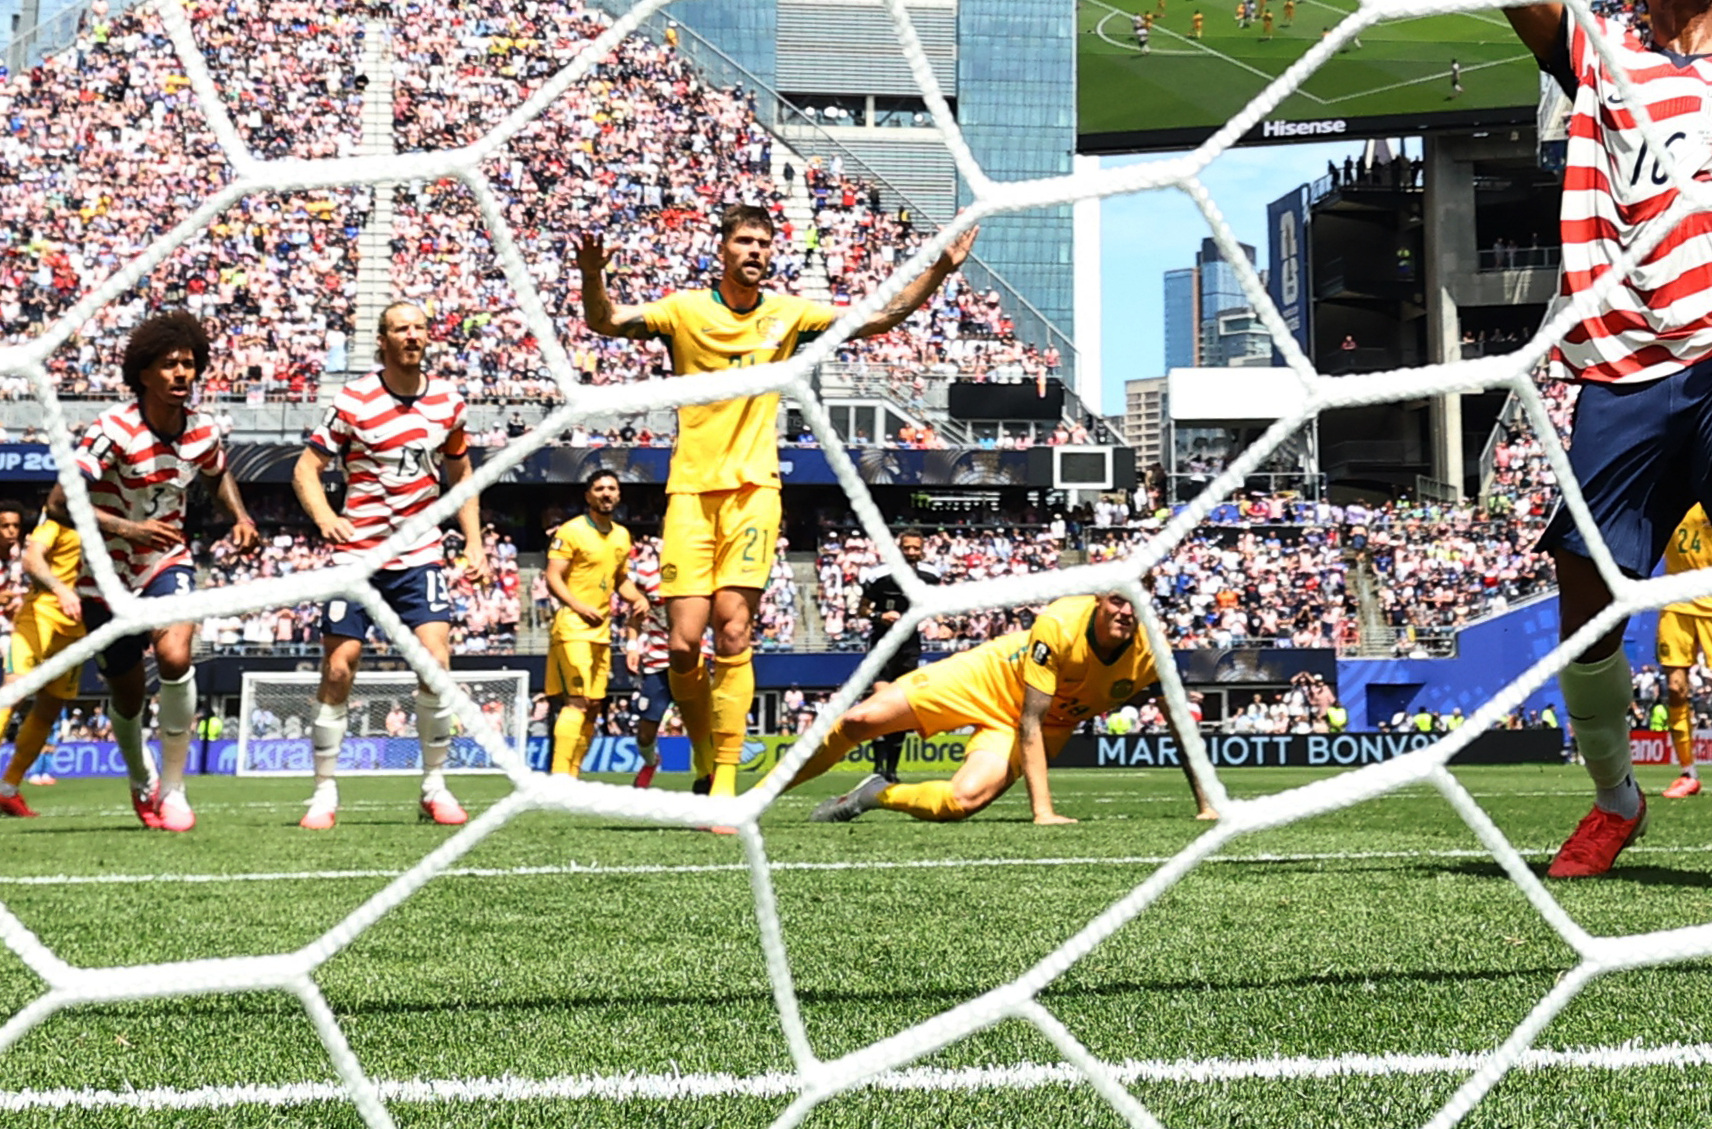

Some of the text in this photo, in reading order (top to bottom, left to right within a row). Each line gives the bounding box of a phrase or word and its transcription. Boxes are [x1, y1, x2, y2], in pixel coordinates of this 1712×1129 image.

[1263, 119, 1347, 138] Hisense
[396, 447, 425, 477] 13
[145, 487, 165, 517] 3
[742, 526, 769, 564] 21
[1677, 527, 1702, 554] 24
[174, 573, 190, 596] 3
[426, 570, 448, 602] 13
[905, 736, 965, 762] libre
[1098, 736, 1293, 765] MARIOTT
